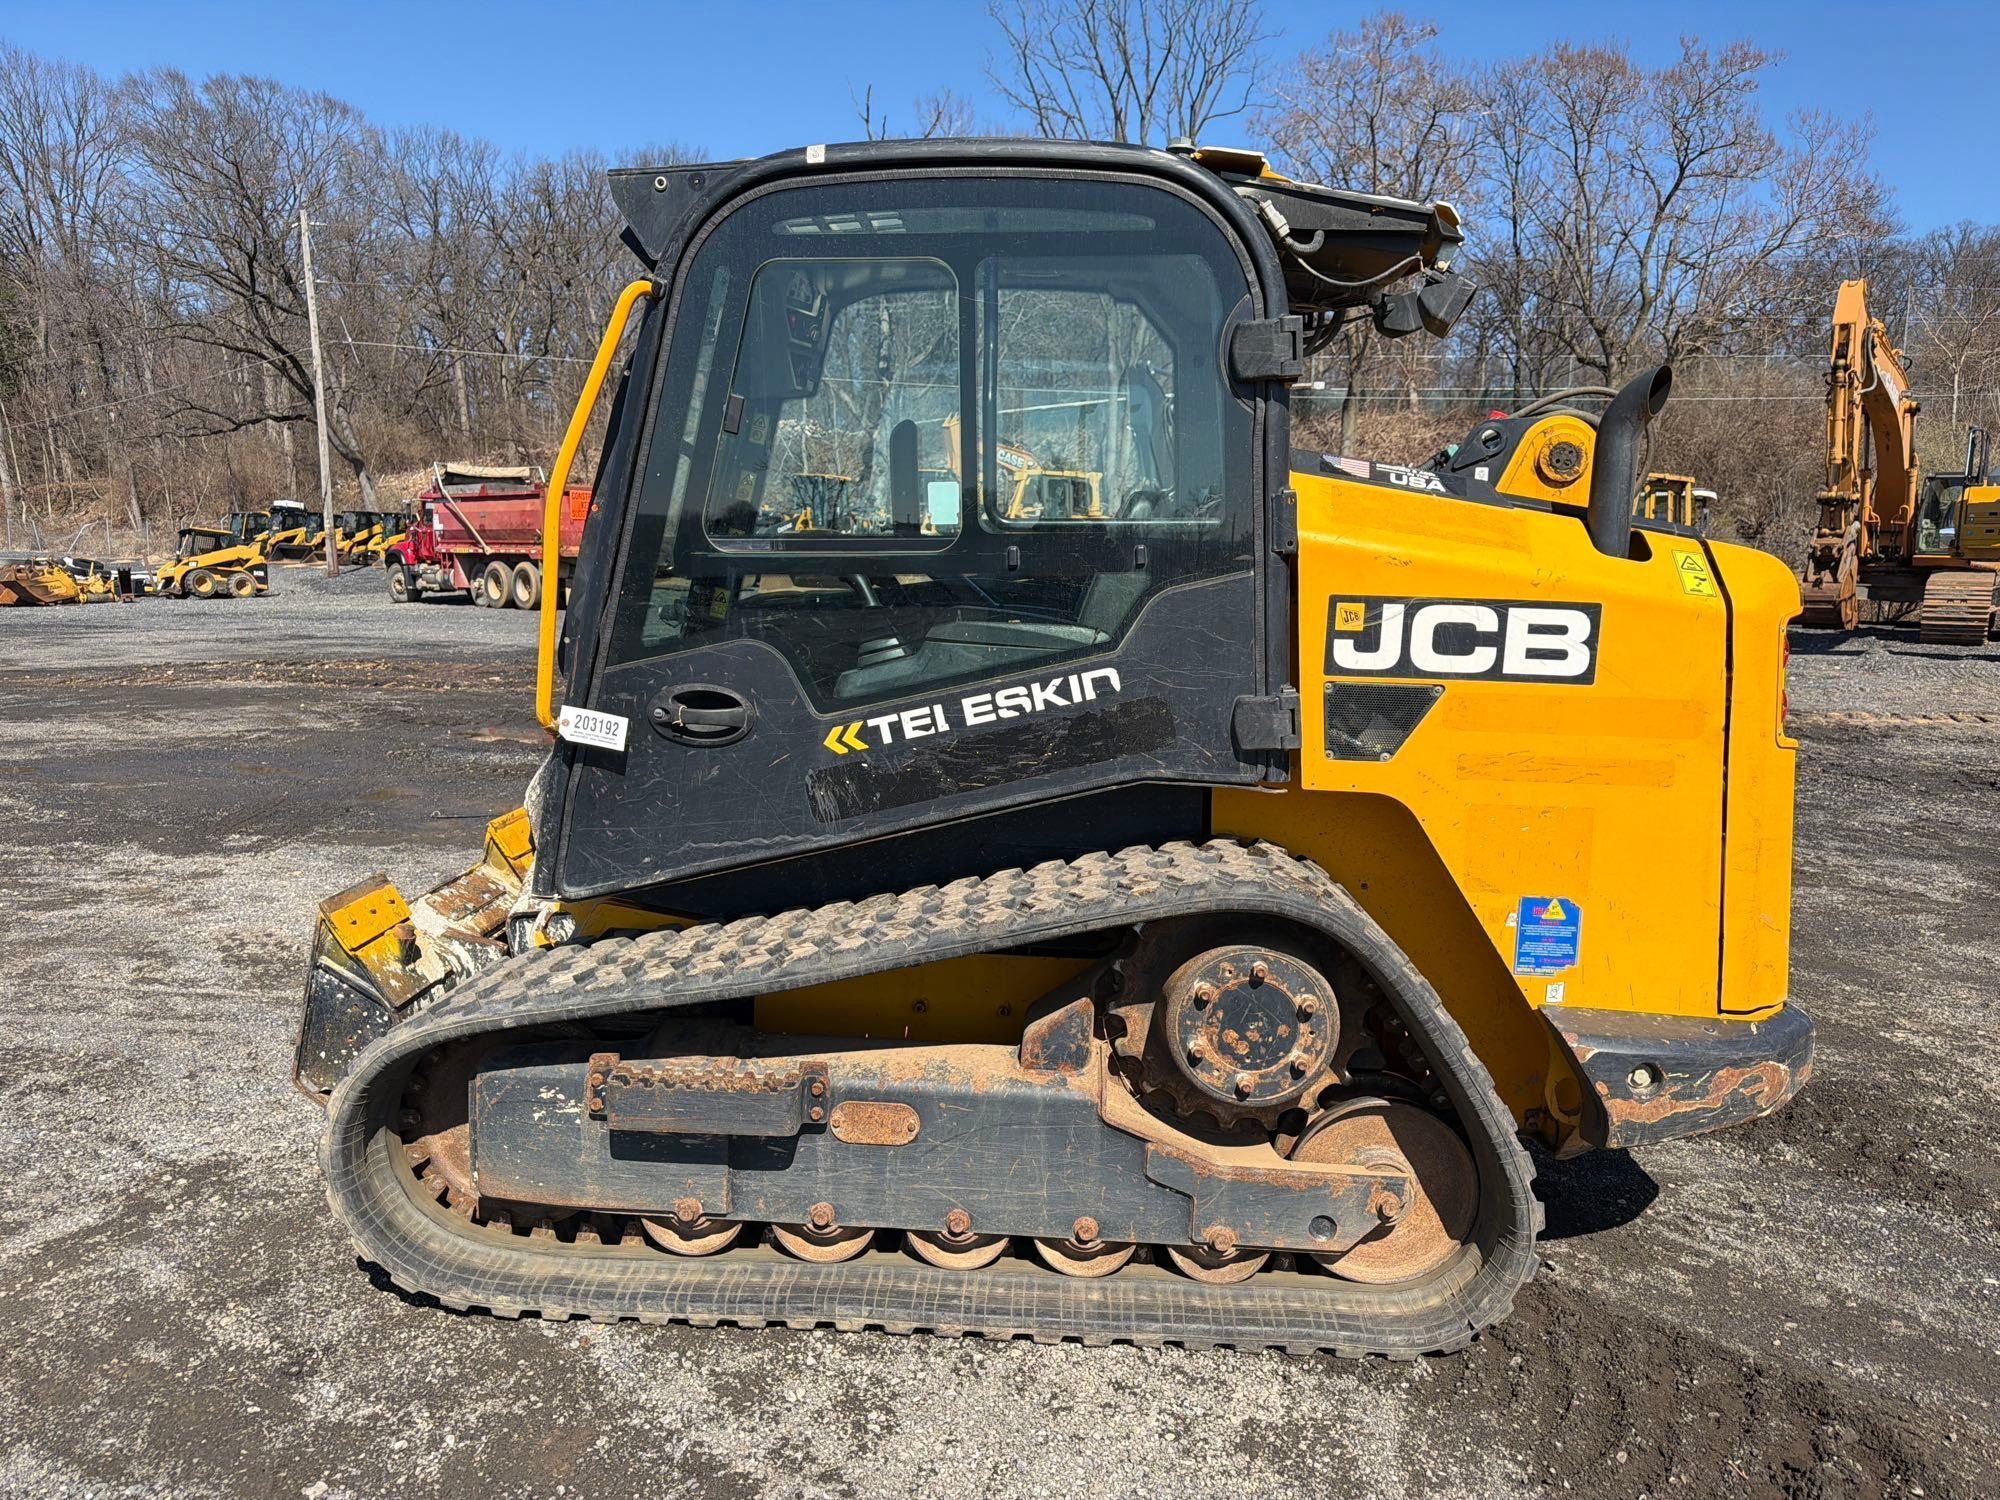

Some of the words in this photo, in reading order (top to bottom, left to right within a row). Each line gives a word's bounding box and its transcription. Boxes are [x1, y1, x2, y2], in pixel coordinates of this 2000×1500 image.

[998, 449, 1024, 467] CASE
[1390, 472, 1446, 492] USA
[1343, 610, 1360, 623] JCB
[1333, 603, 1591, 677] JCB
[574, 714, 620, 737] 203192
